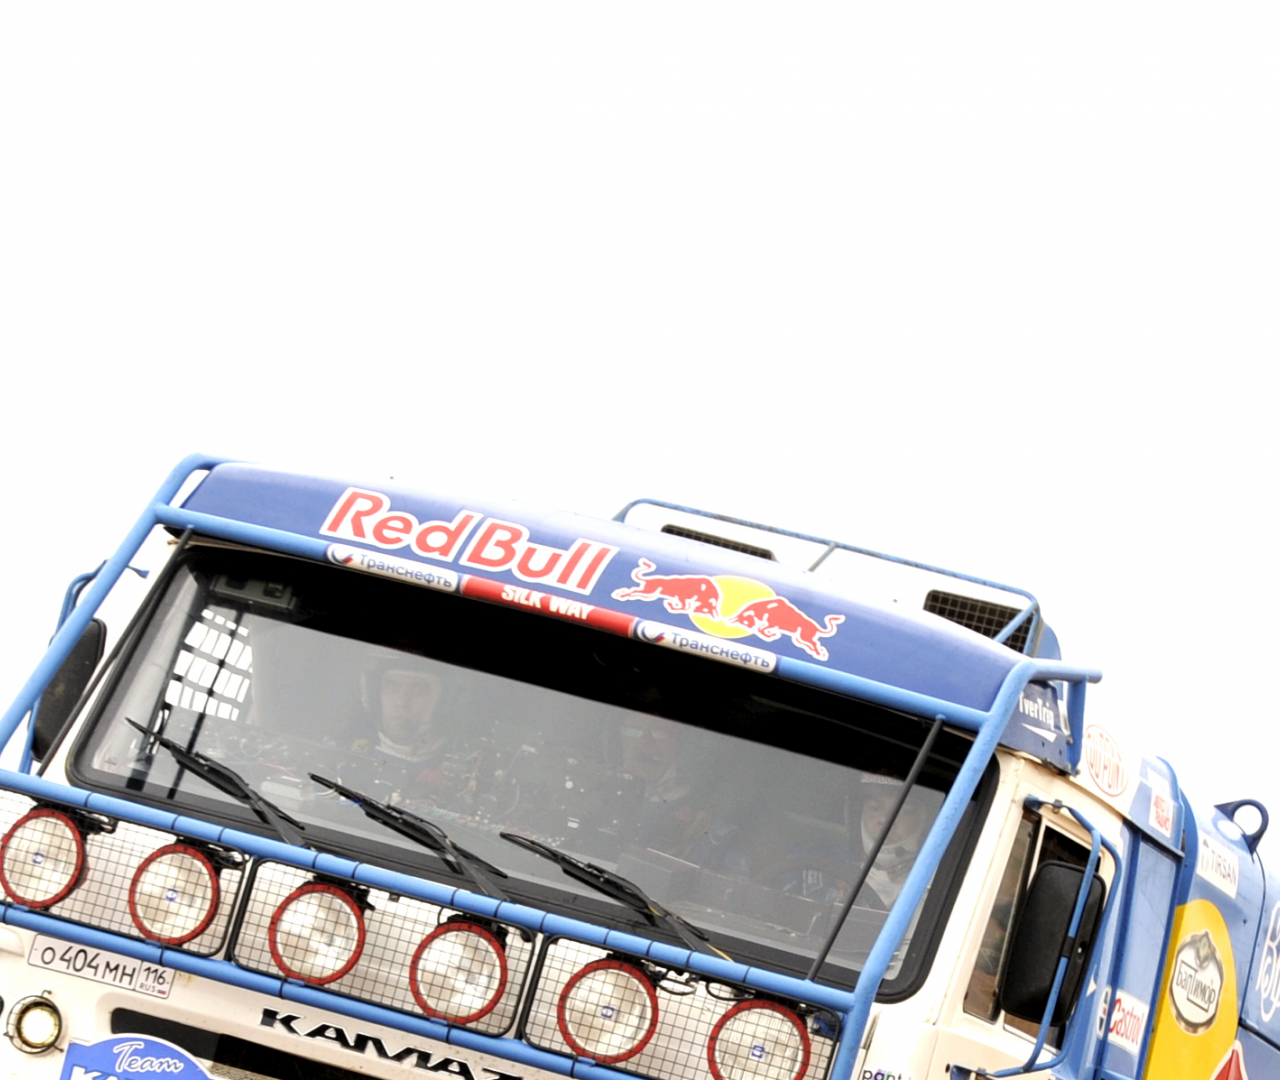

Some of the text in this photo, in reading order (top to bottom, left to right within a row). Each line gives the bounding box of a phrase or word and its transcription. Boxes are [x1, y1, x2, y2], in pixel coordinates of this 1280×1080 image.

[323, 488, 620, 595] Red Bull
[359, 553, 453, 588] Транснефть
[501, 585, 595, 620] SILK WAY
[672, 631, 770, 669] Транснефть
[139, 981, 157, 993] RUS
[142, 965, 167, 984] 116
[1109, 998, 1145, 1046] Castrol
[113, 1041, 184, 1073] Team
